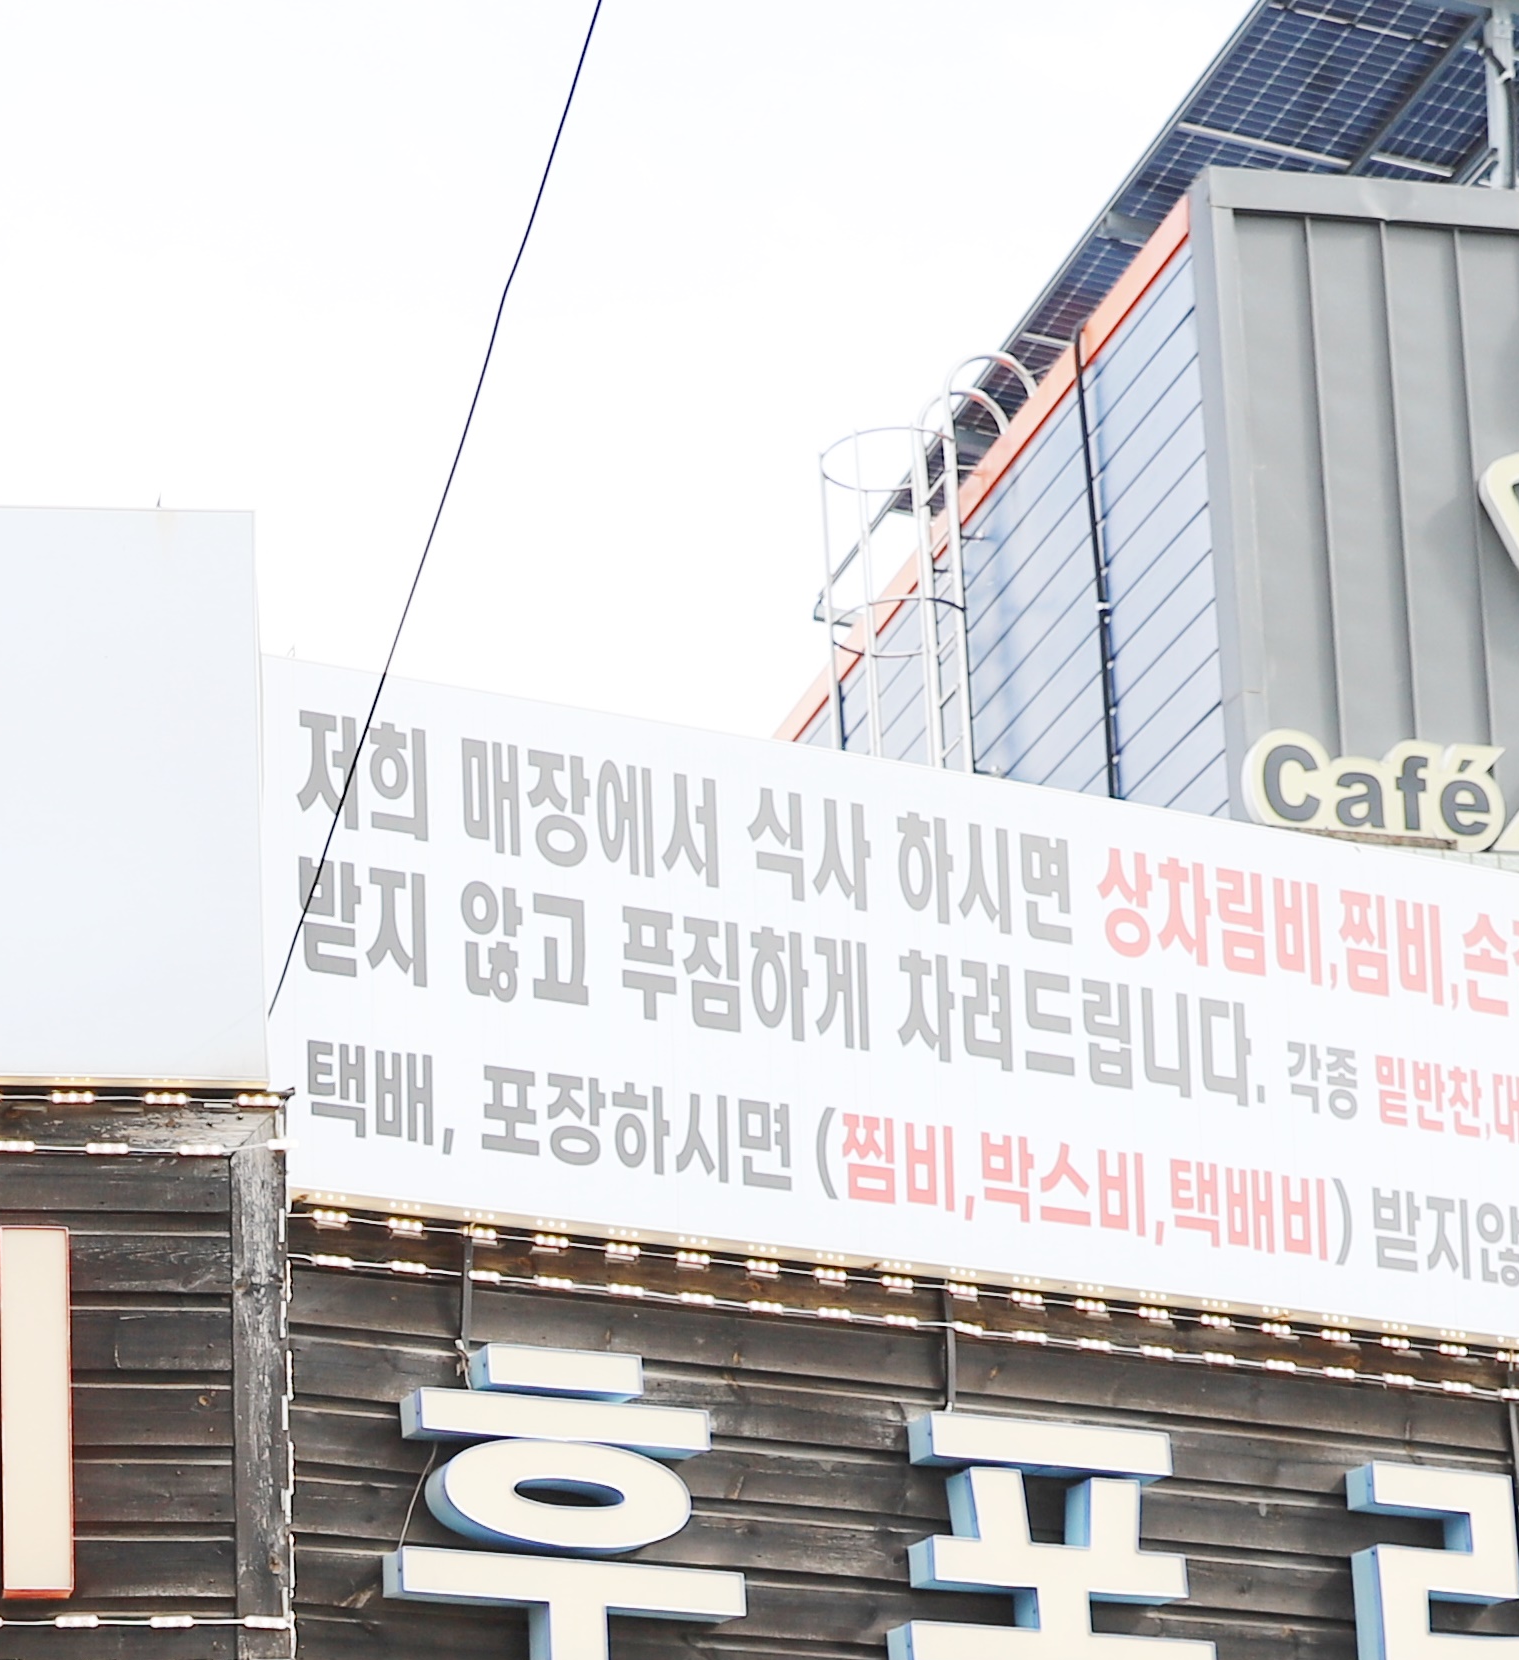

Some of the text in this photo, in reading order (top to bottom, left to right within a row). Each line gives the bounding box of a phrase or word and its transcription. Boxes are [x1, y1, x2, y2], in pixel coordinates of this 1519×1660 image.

[294, 706, 432, 846] 저희
[459, 735, 721, 888] 매장에서
[747, 786, 871, 915] 식사
[897, 813, 1076, 945] 하시면
[1256, 736, 1492, 846] Café
[297, 853, 432, 989] 받지
[458, 875, 592, 1011] 않고
[619, 906, 871, 1056] 푸짐하게
[896, 941, 1269, 1110] 차려드립니다.
[1286, 1038, 1359, 1119] 각종
[306, 1036, 454, 1164] 택배,
[479, 1065, 793, 1197] 포장하시면
